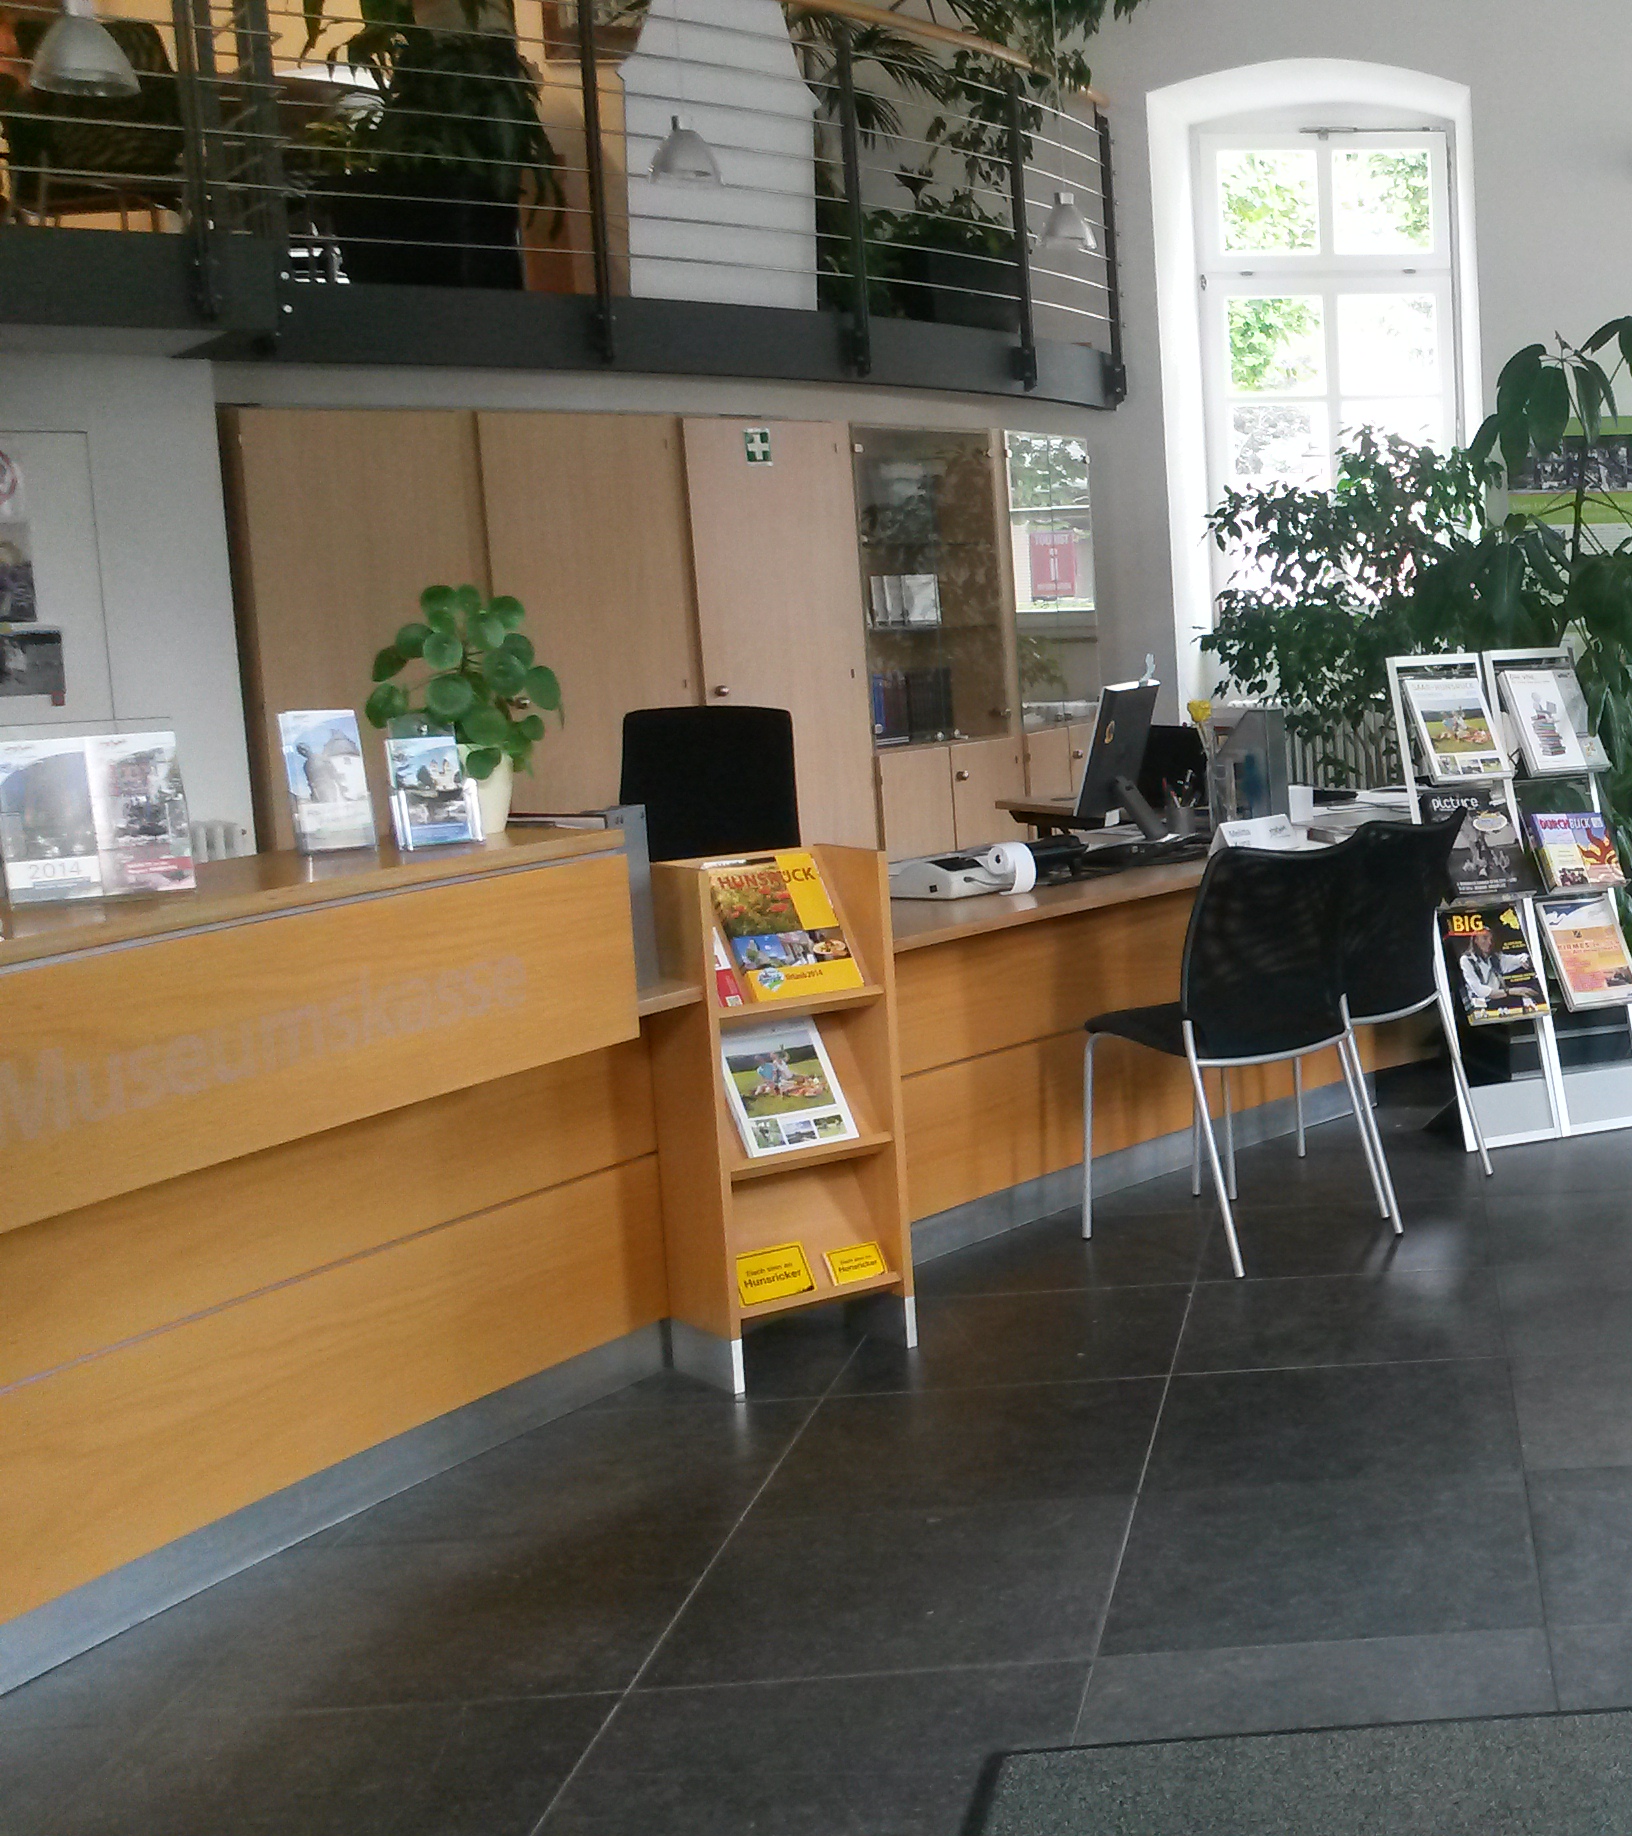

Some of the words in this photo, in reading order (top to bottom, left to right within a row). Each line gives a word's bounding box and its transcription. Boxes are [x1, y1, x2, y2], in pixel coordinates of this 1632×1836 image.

[1431, 796, 1479, 812] picture
[29, 860, 82, 880] 2014
[1452, 914, 1485, 932] BIG
[0, 953, 528, 1149] Museumskasse
[744, 1269, 802, 1289] Hunsricker
